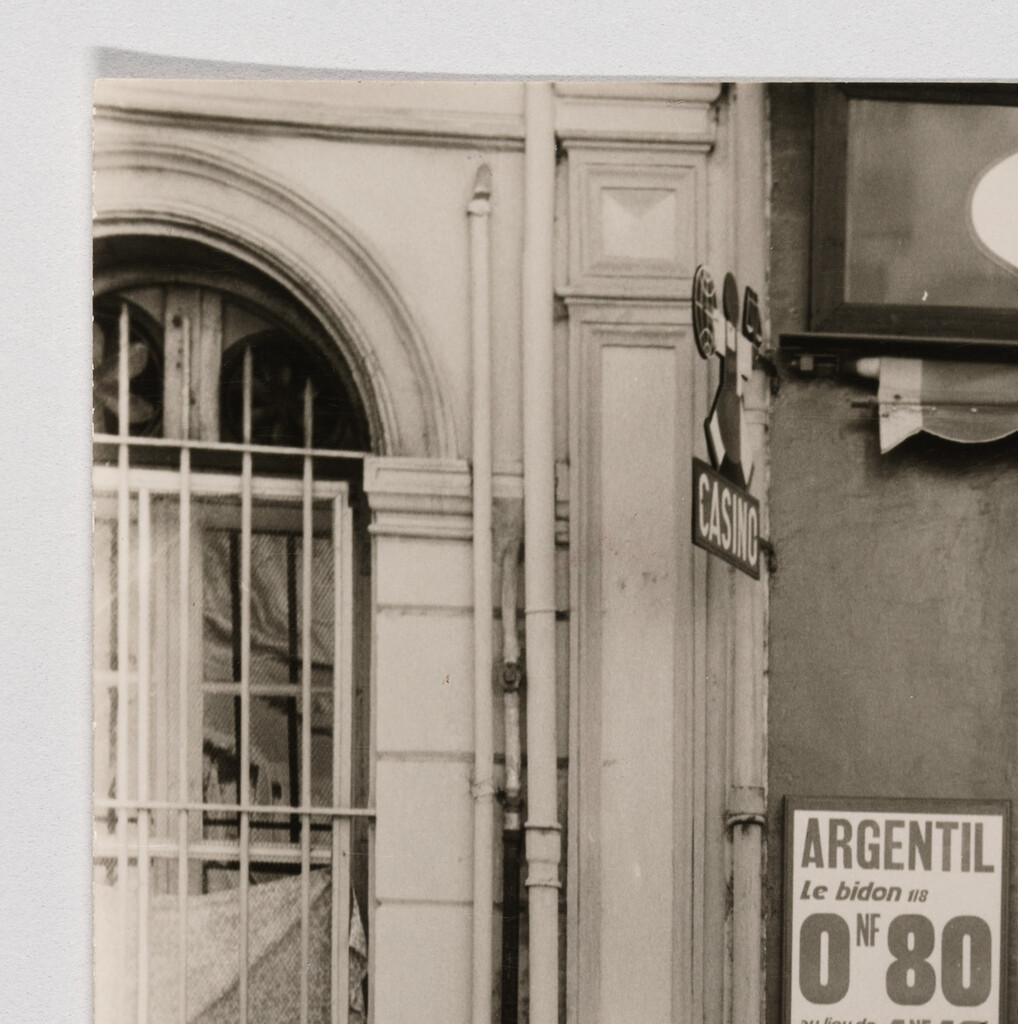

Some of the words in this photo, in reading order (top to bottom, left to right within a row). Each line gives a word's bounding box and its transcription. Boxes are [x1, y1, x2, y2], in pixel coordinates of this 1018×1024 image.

[698, 472, 758, 567] CASINO
[801, 817, 995, 873] ARGENTIL
[800, 880, 828, 900] Le
[836, 881, 903, 902] bidon
[799, 912, 850, 1005] 0
[856, 912, 881, 947] NF
[886, 913, 992, 1007] 80
